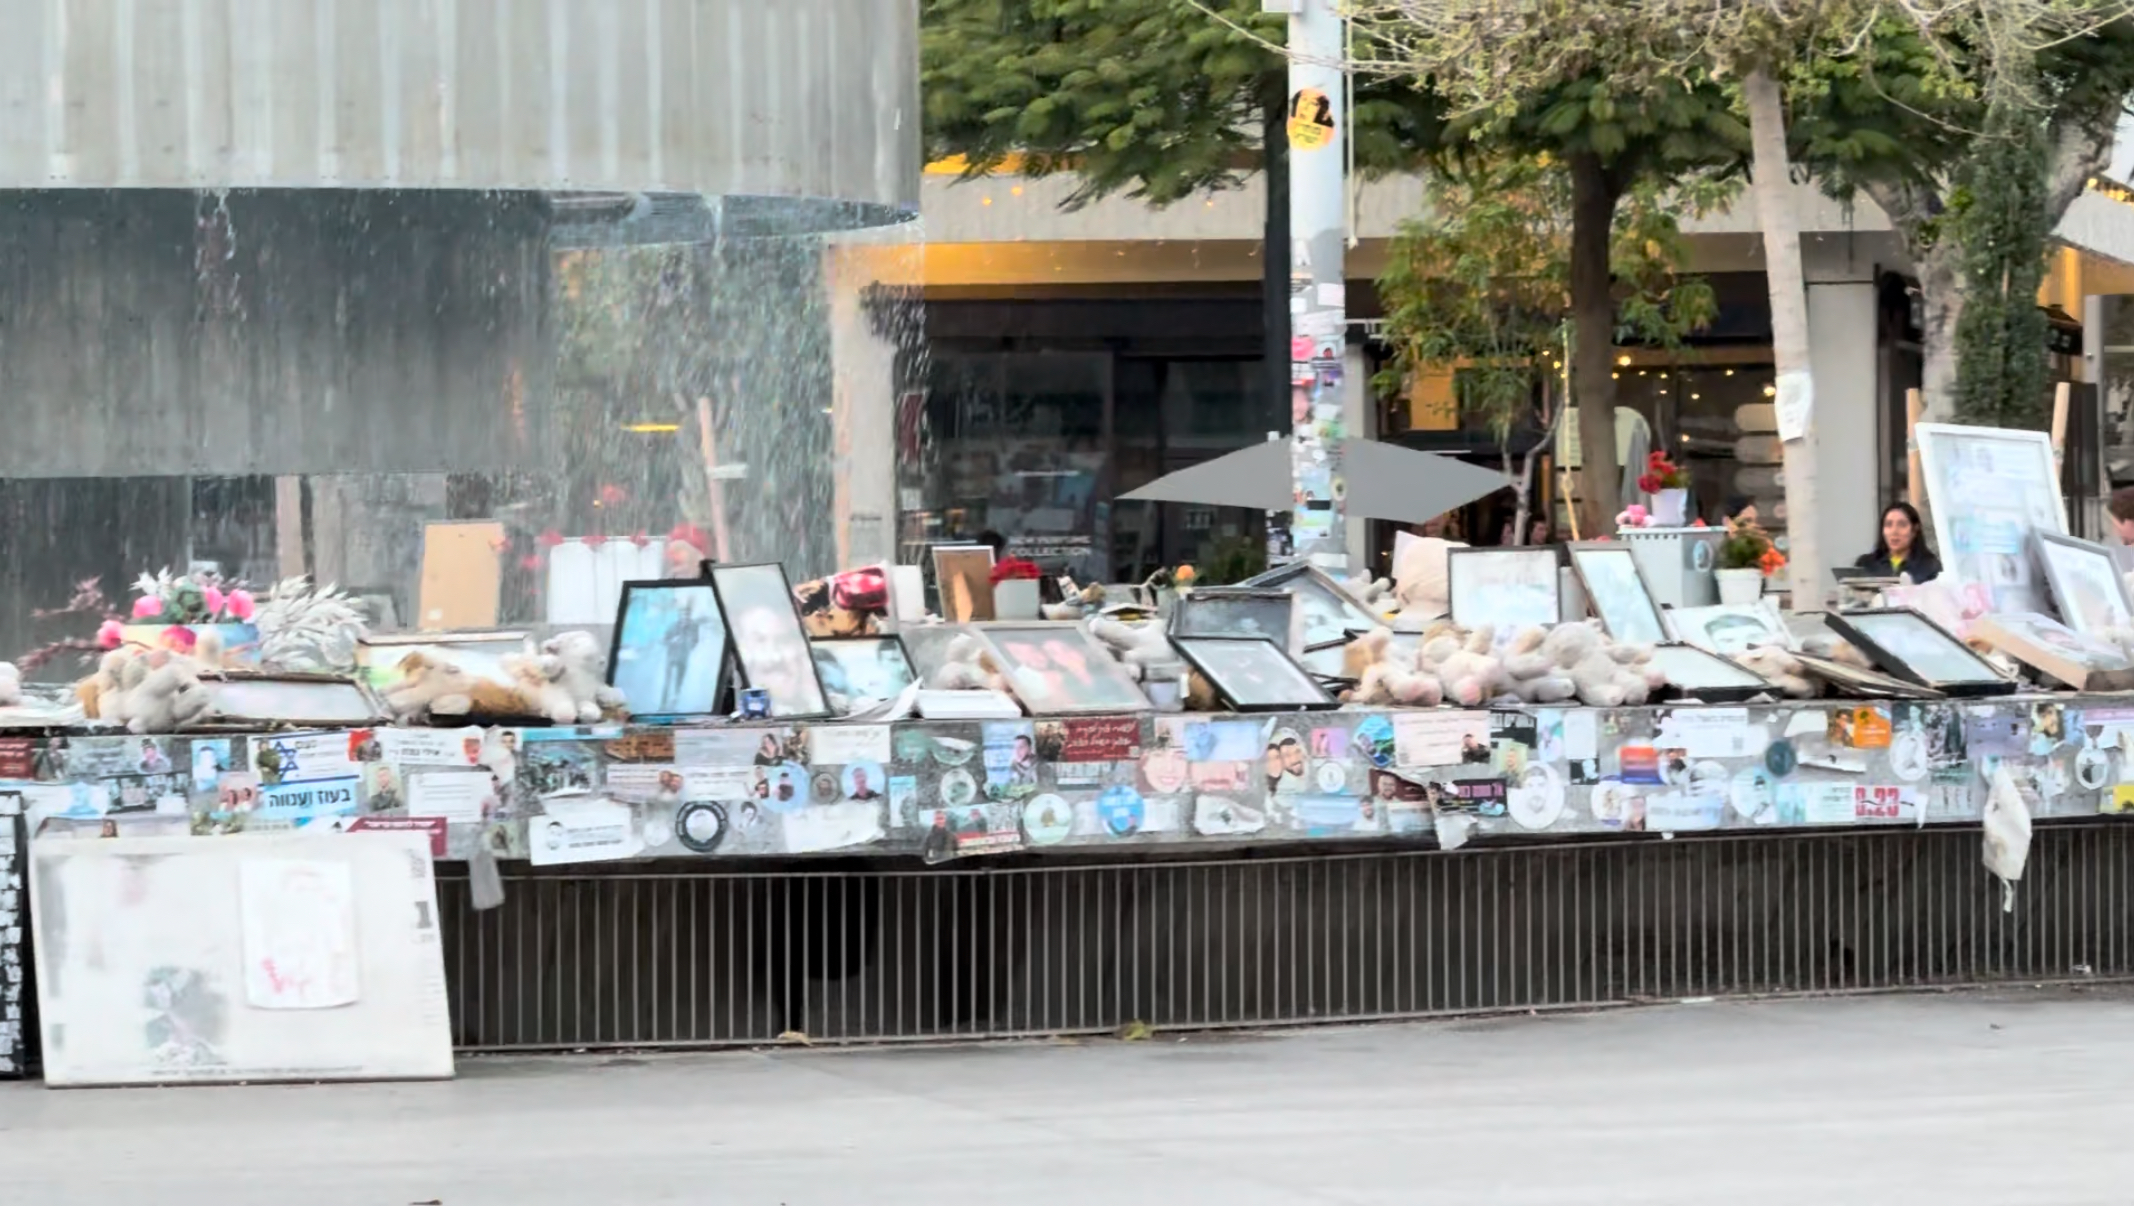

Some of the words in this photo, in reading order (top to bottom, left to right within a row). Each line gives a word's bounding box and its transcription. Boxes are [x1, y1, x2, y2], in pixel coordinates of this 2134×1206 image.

[1008, 546, 1092, 557] COLLECTION
[269, 790, 313, 808] וענווה
[317, 788, 351, 804] בעוז
